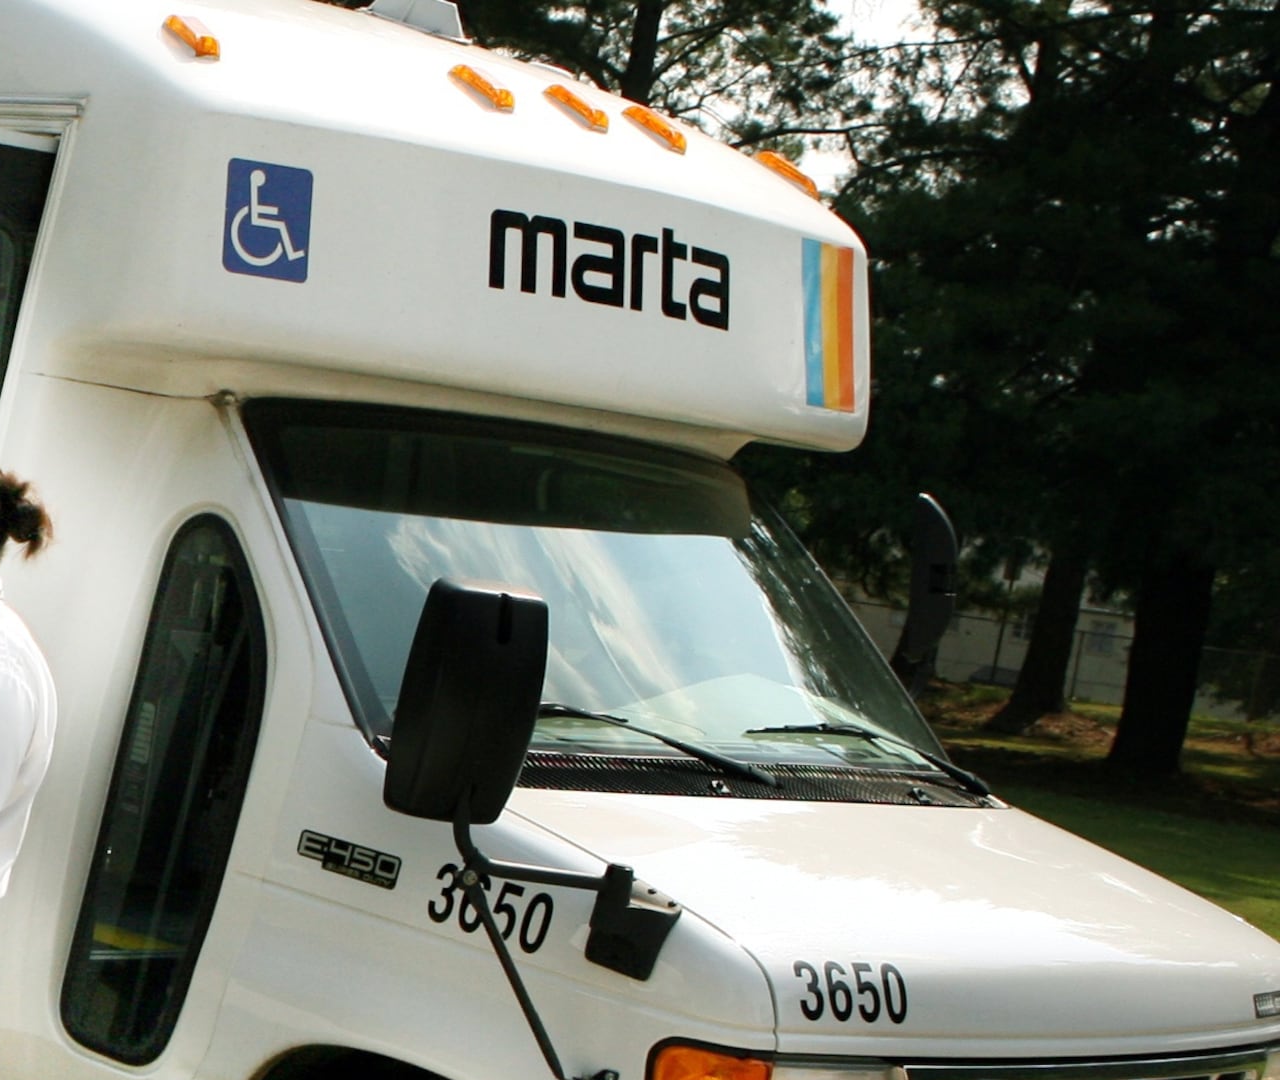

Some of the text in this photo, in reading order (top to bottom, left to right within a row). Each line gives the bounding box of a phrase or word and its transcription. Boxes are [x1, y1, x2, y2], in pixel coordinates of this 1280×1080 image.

[488, 208, 730, 331] marta
[428, 863, 554, 954] 3650
[793, 960, 908, 1024] 3650
